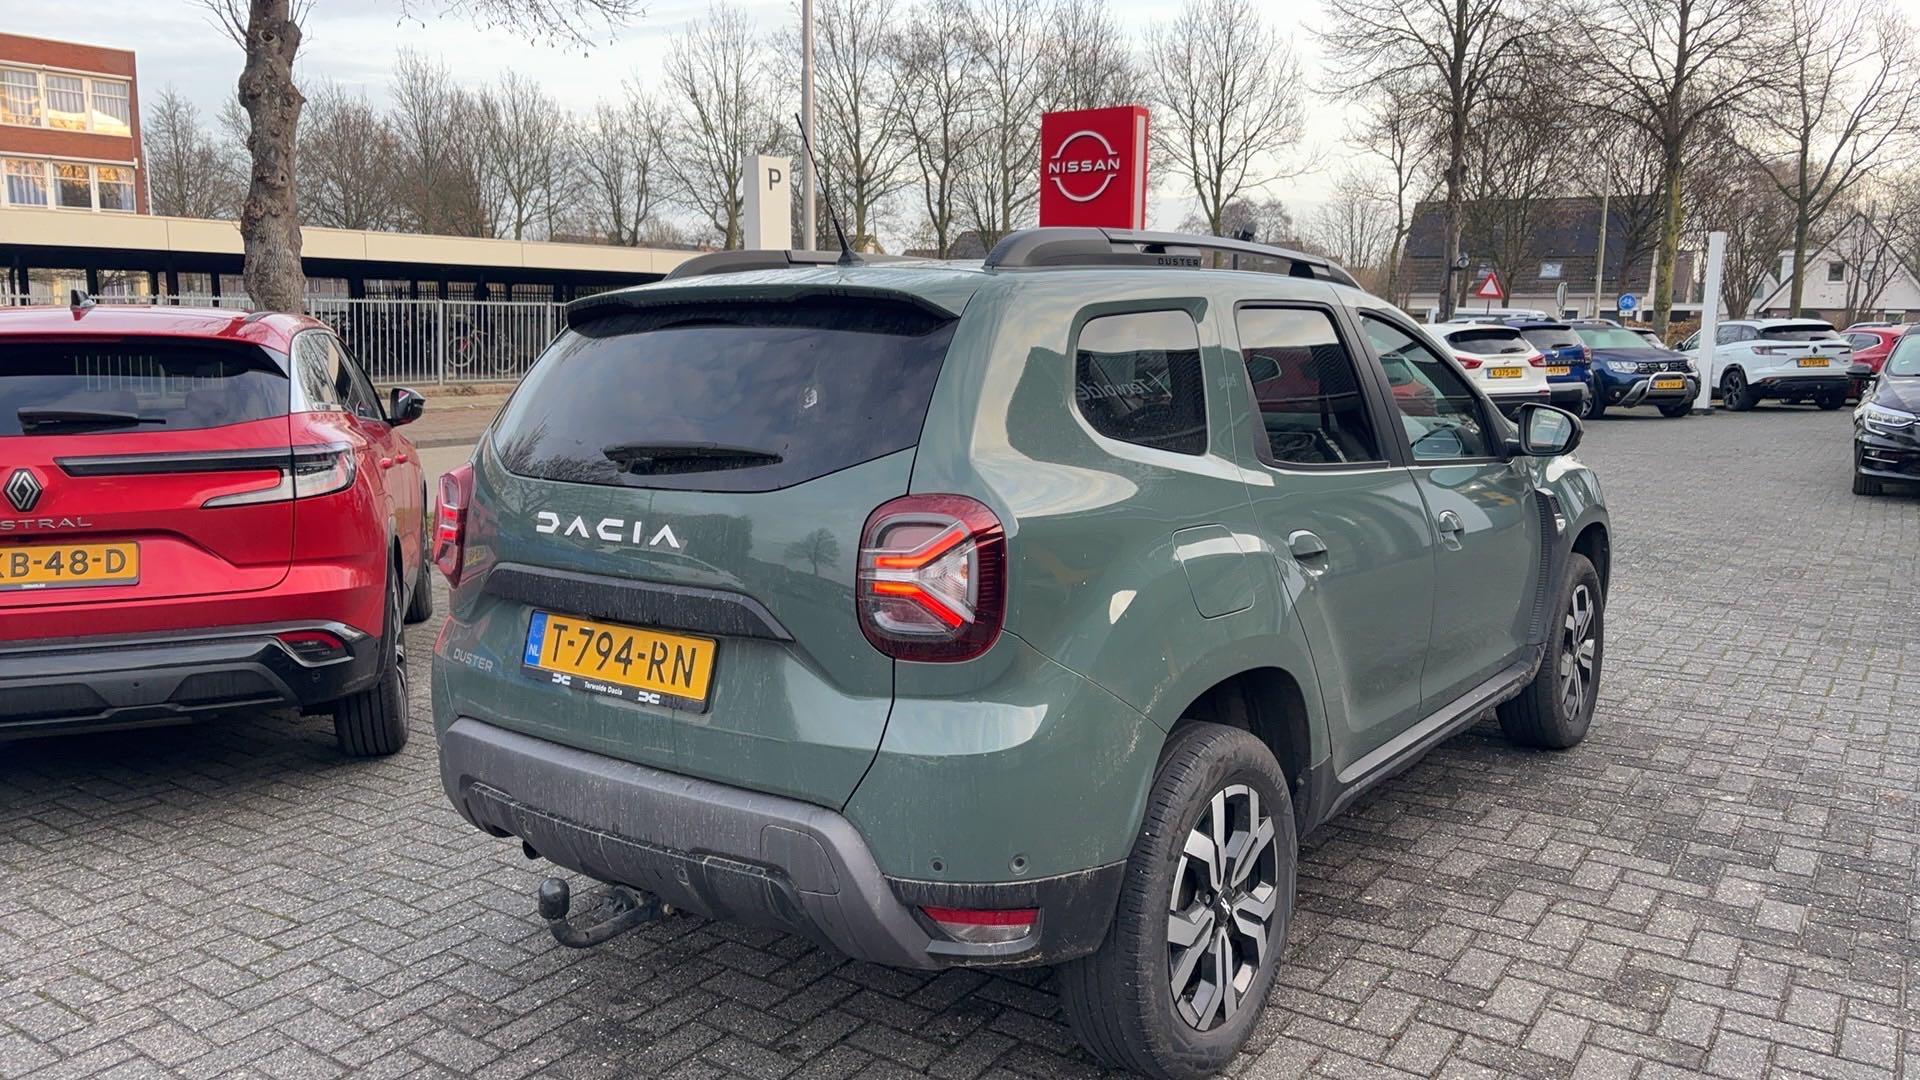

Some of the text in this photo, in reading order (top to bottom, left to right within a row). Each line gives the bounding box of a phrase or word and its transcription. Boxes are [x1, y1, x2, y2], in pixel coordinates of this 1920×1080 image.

[1048, 158, 1120, 174] NISSAN
[768, 167, 781, 191] P
[1158, 257, 1199, 267] DUSTER
[0, 517, 92, 531] STRAL
[536, 511, 680, 549] DACIA
[529, 644, 539, 656] NL
[553, 623, 697, 688] T-794-RN
[453, 648, 493, 672] DUSTER
[584, 681, 623, 696] Terwolde Dacia
